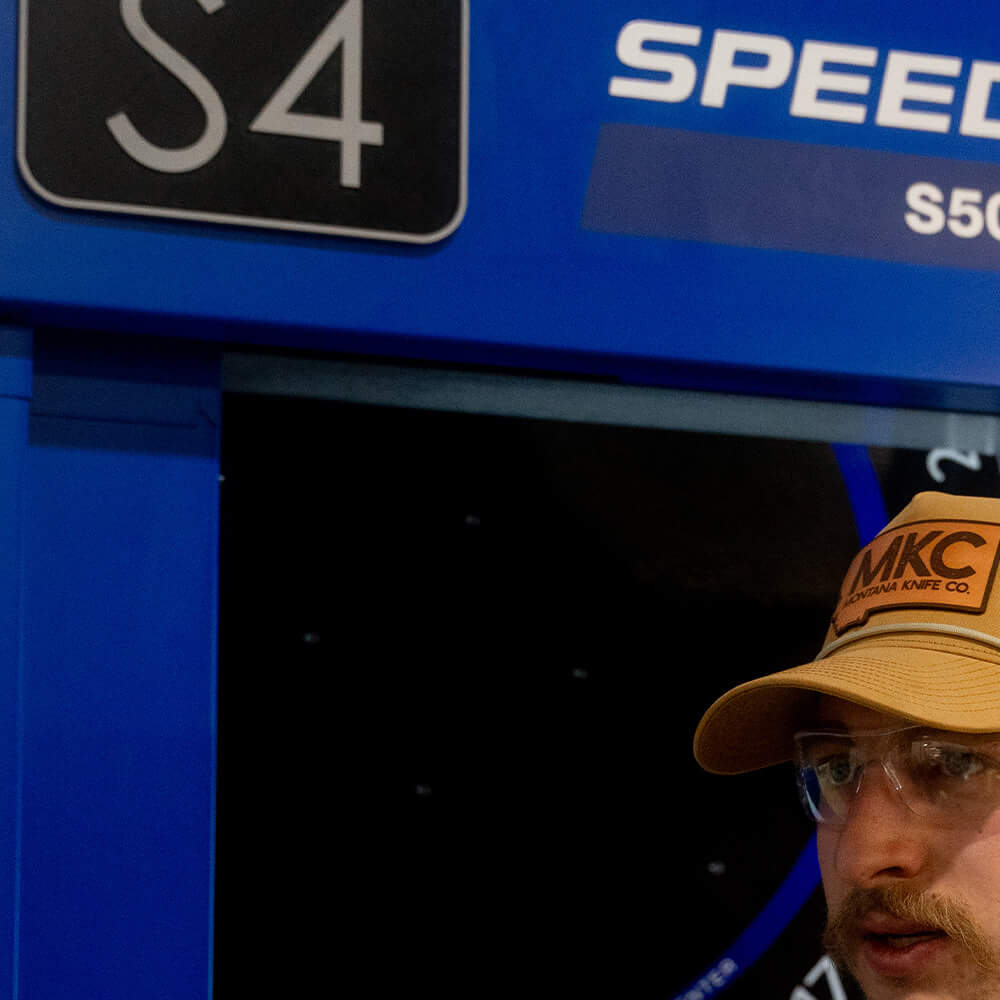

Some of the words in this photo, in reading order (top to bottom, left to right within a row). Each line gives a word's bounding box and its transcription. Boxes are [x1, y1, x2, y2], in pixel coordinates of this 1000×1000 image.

[106, 0, 384, 189] S4
[849, 530, 988, 594] MKC
[900, 579, 942, 592] KNIFE
[945, 581, 971, 595] CO.
